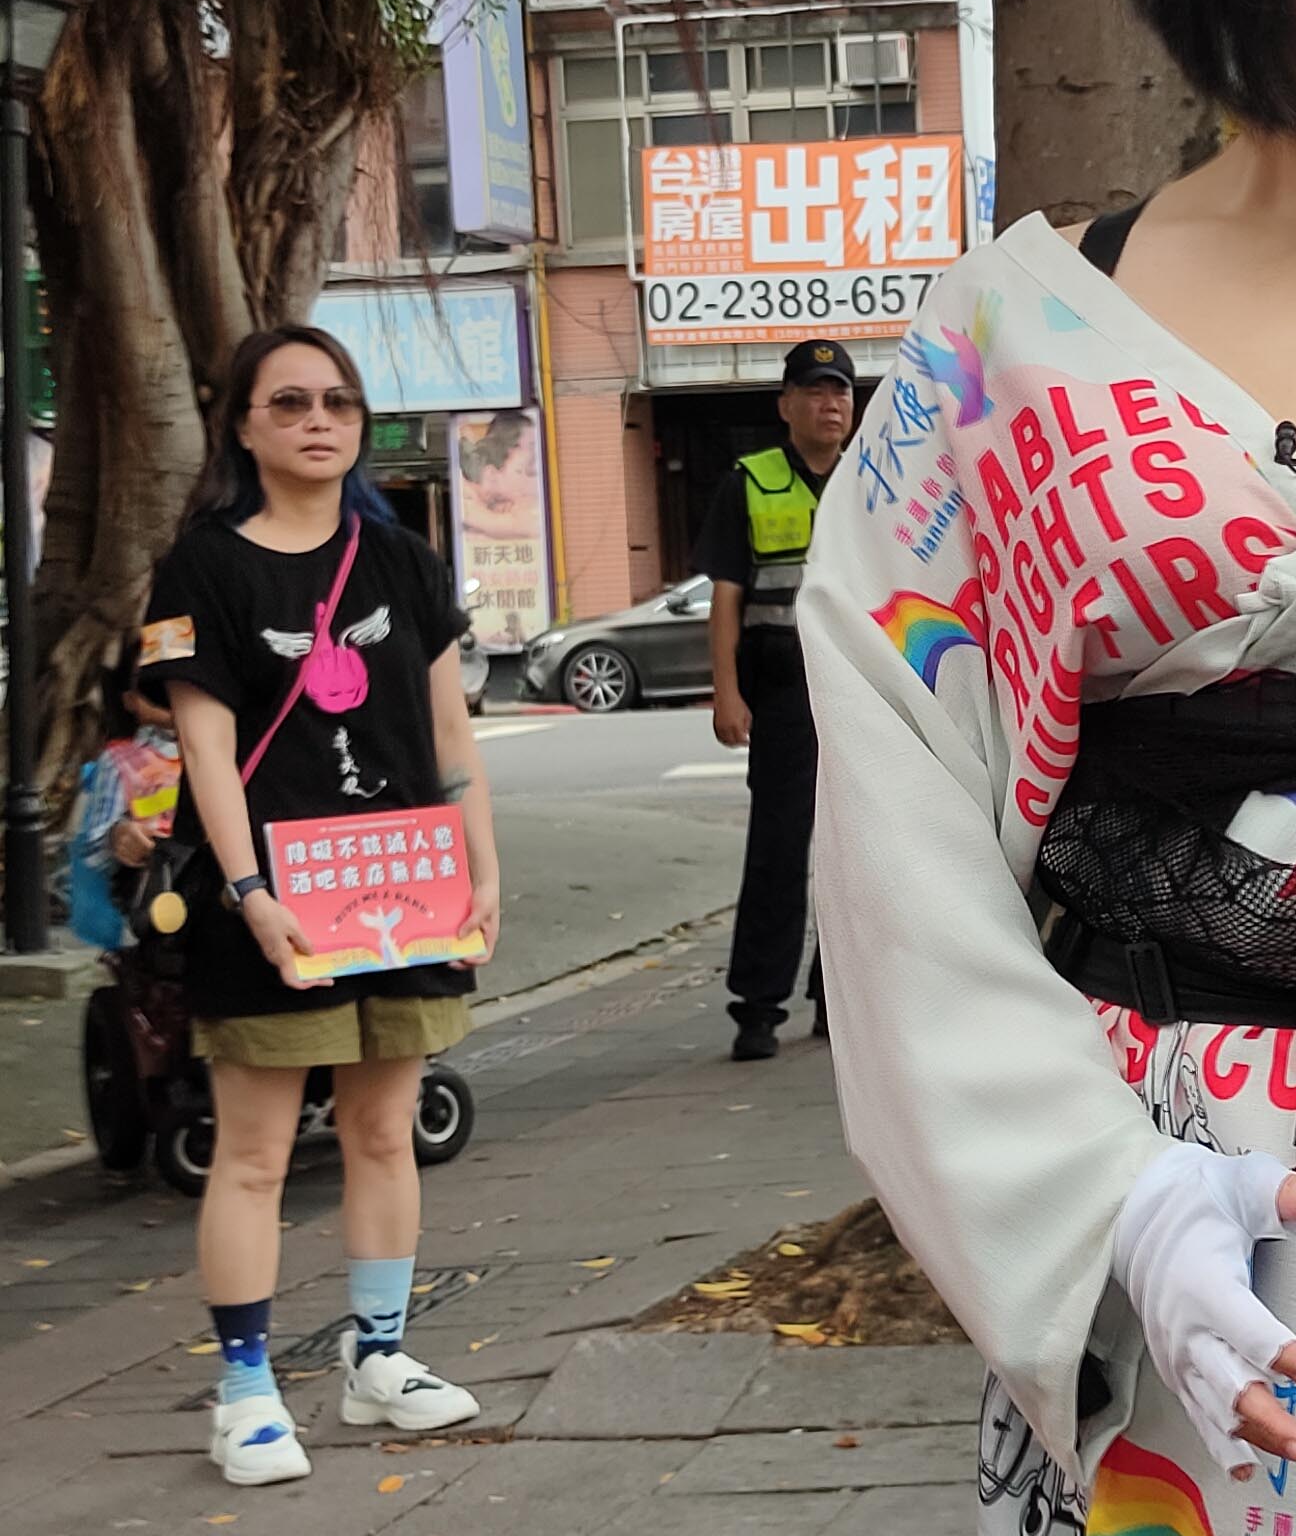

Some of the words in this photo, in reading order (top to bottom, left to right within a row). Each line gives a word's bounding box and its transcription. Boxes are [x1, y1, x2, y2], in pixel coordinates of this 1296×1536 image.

[650, 147, 743, 195] 台灣
[651, 197, 744, 242] 房屋
[751, 143, 959, 268] 出租
[648, 272, 944, 323] 02-2388-657
[473, 544, 534, 566] 新天地
